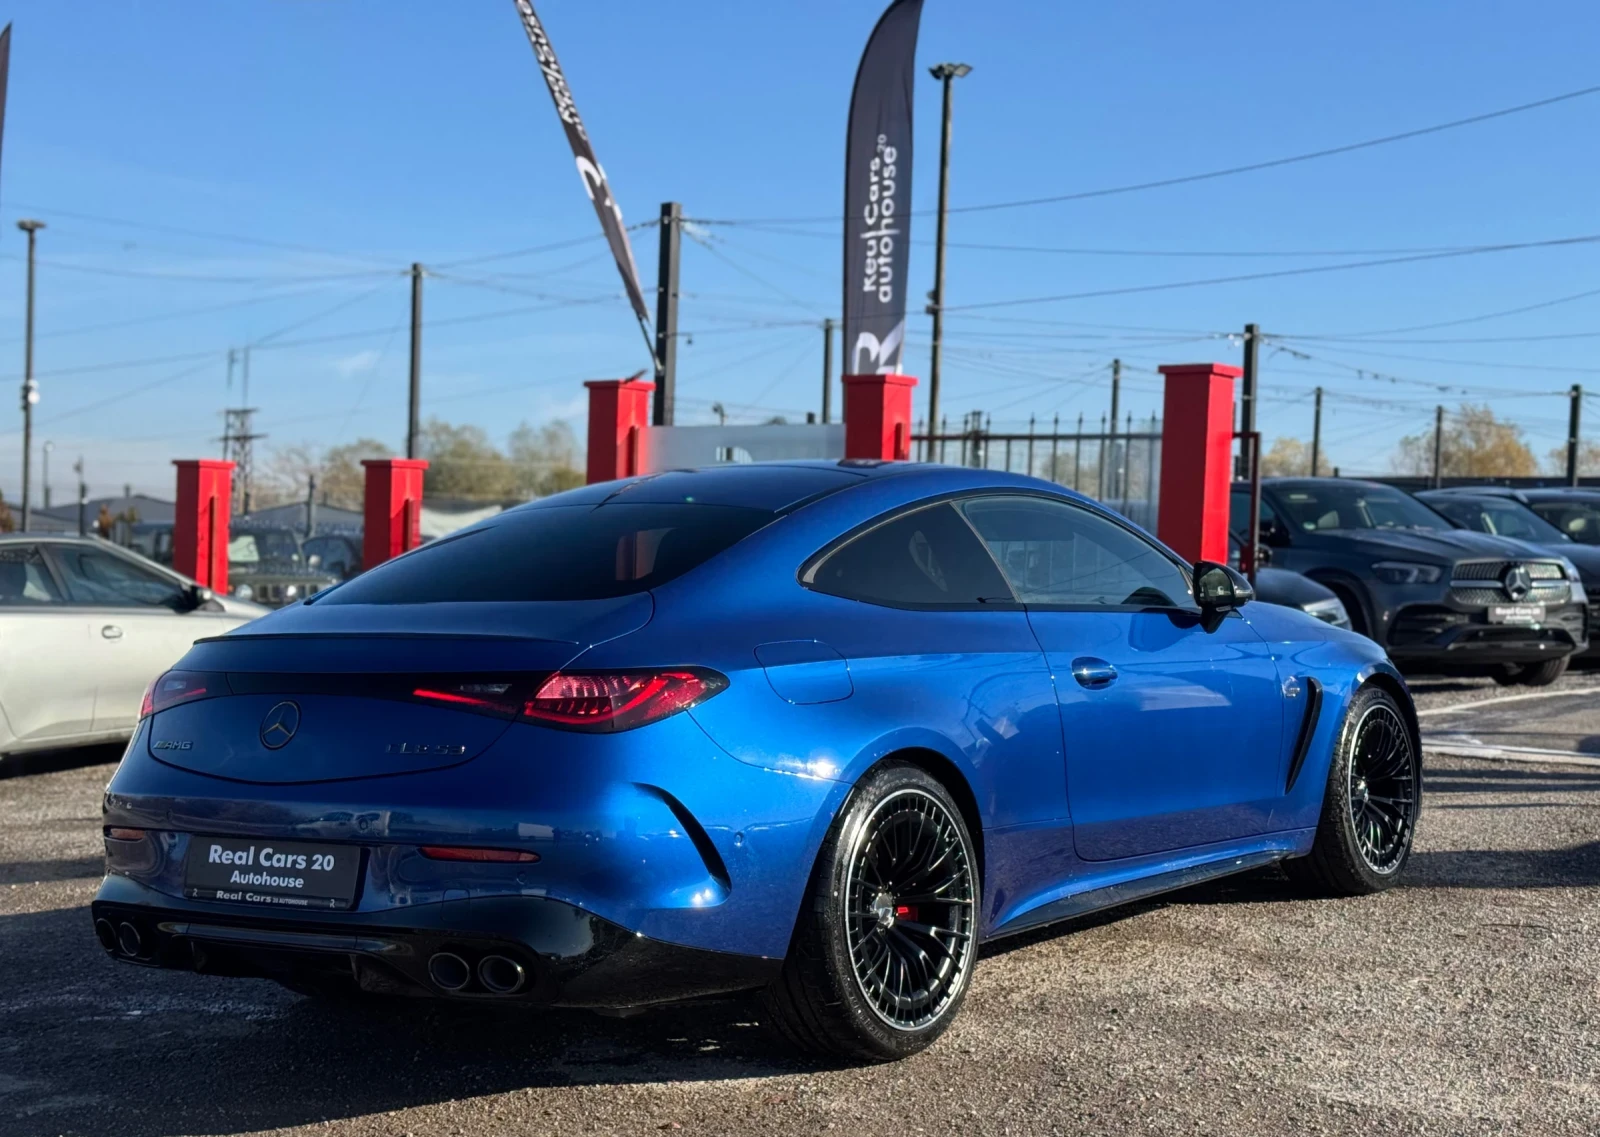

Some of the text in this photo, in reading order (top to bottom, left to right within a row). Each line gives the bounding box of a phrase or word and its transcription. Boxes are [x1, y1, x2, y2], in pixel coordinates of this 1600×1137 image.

[864, 157, 881, 226] Cars
[877, 133, 888, 154] 20
[878, 146, 899, 303] autohouse
[162, 741, 193, 750] AMG
[208, 844, 335, 871] Real Cars 20
[230, 870, 304, 888] Autohouse
[216, 890, 241, 901] Real
[245, 892, 272, 903] Cars
